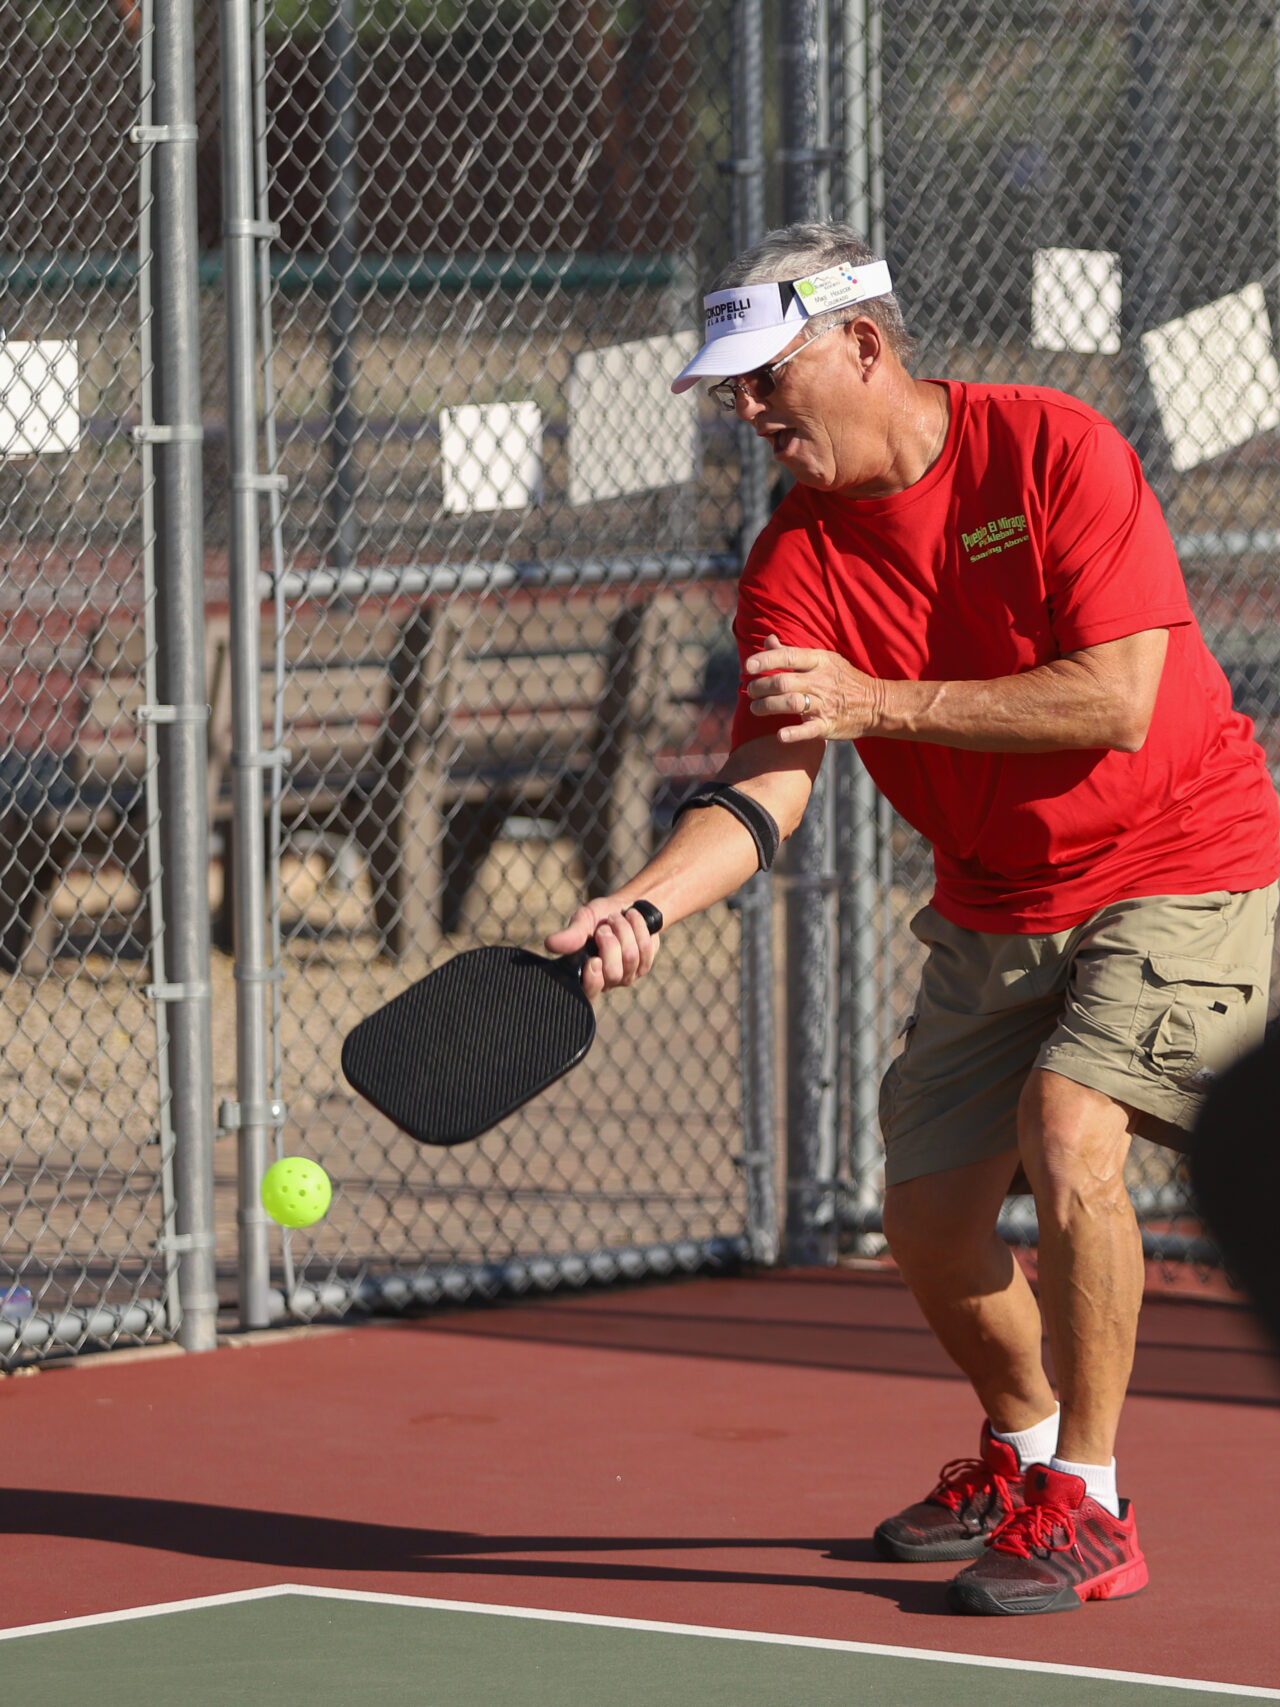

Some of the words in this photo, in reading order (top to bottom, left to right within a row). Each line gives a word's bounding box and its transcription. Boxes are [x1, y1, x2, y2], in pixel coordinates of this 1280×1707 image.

[705, 298, 751, 319] OKOPELLI
[961, 526, 988, 552] Pueblo
[987, 521, 998, 533] El
[997, 514, 1027, 532] Mirage
[979, 528, 1015, 548] Pickleball
[970, 545, 1002, 563] Soaring
[1003, 535, 1029, 549] Above
